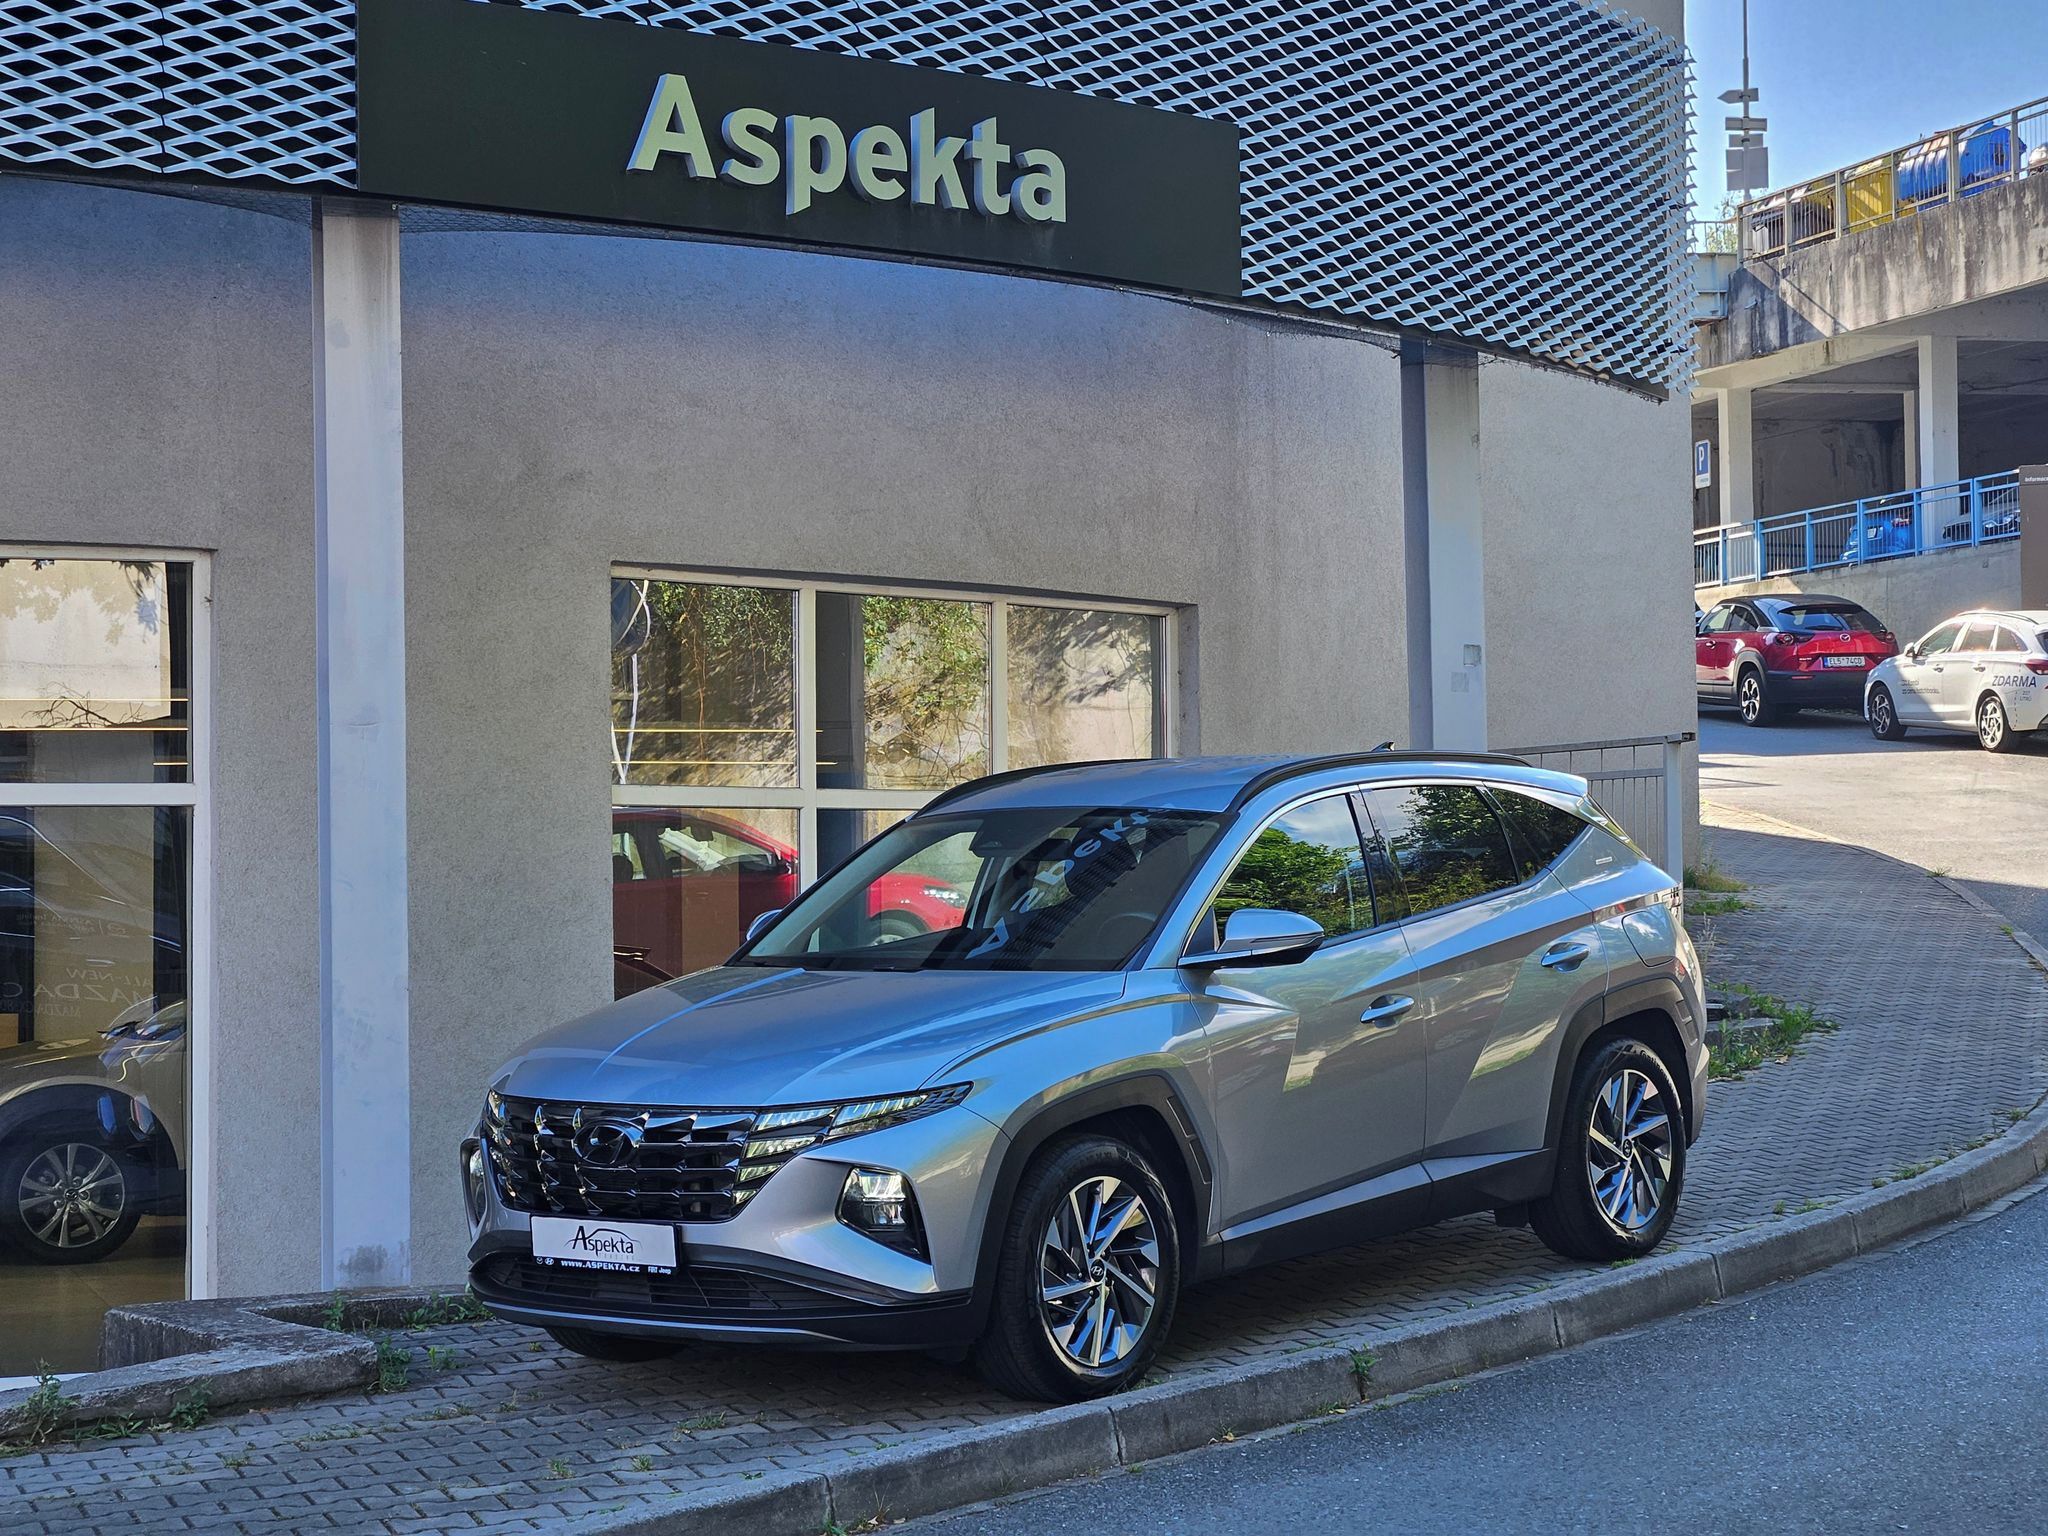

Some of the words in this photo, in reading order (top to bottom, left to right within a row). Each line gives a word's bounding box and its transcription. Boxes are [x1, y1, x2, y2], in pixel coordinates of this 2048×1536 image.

[625, 72, 1067, 223] Aspekta
[1698, 446, 1705, 471] P
[1991, 675, 2037, 688] ZDARMA
[572, 1225, 634, 1257] Aspekta
[560, 1259, 640, 1272] www.ASPEKTA.cz
